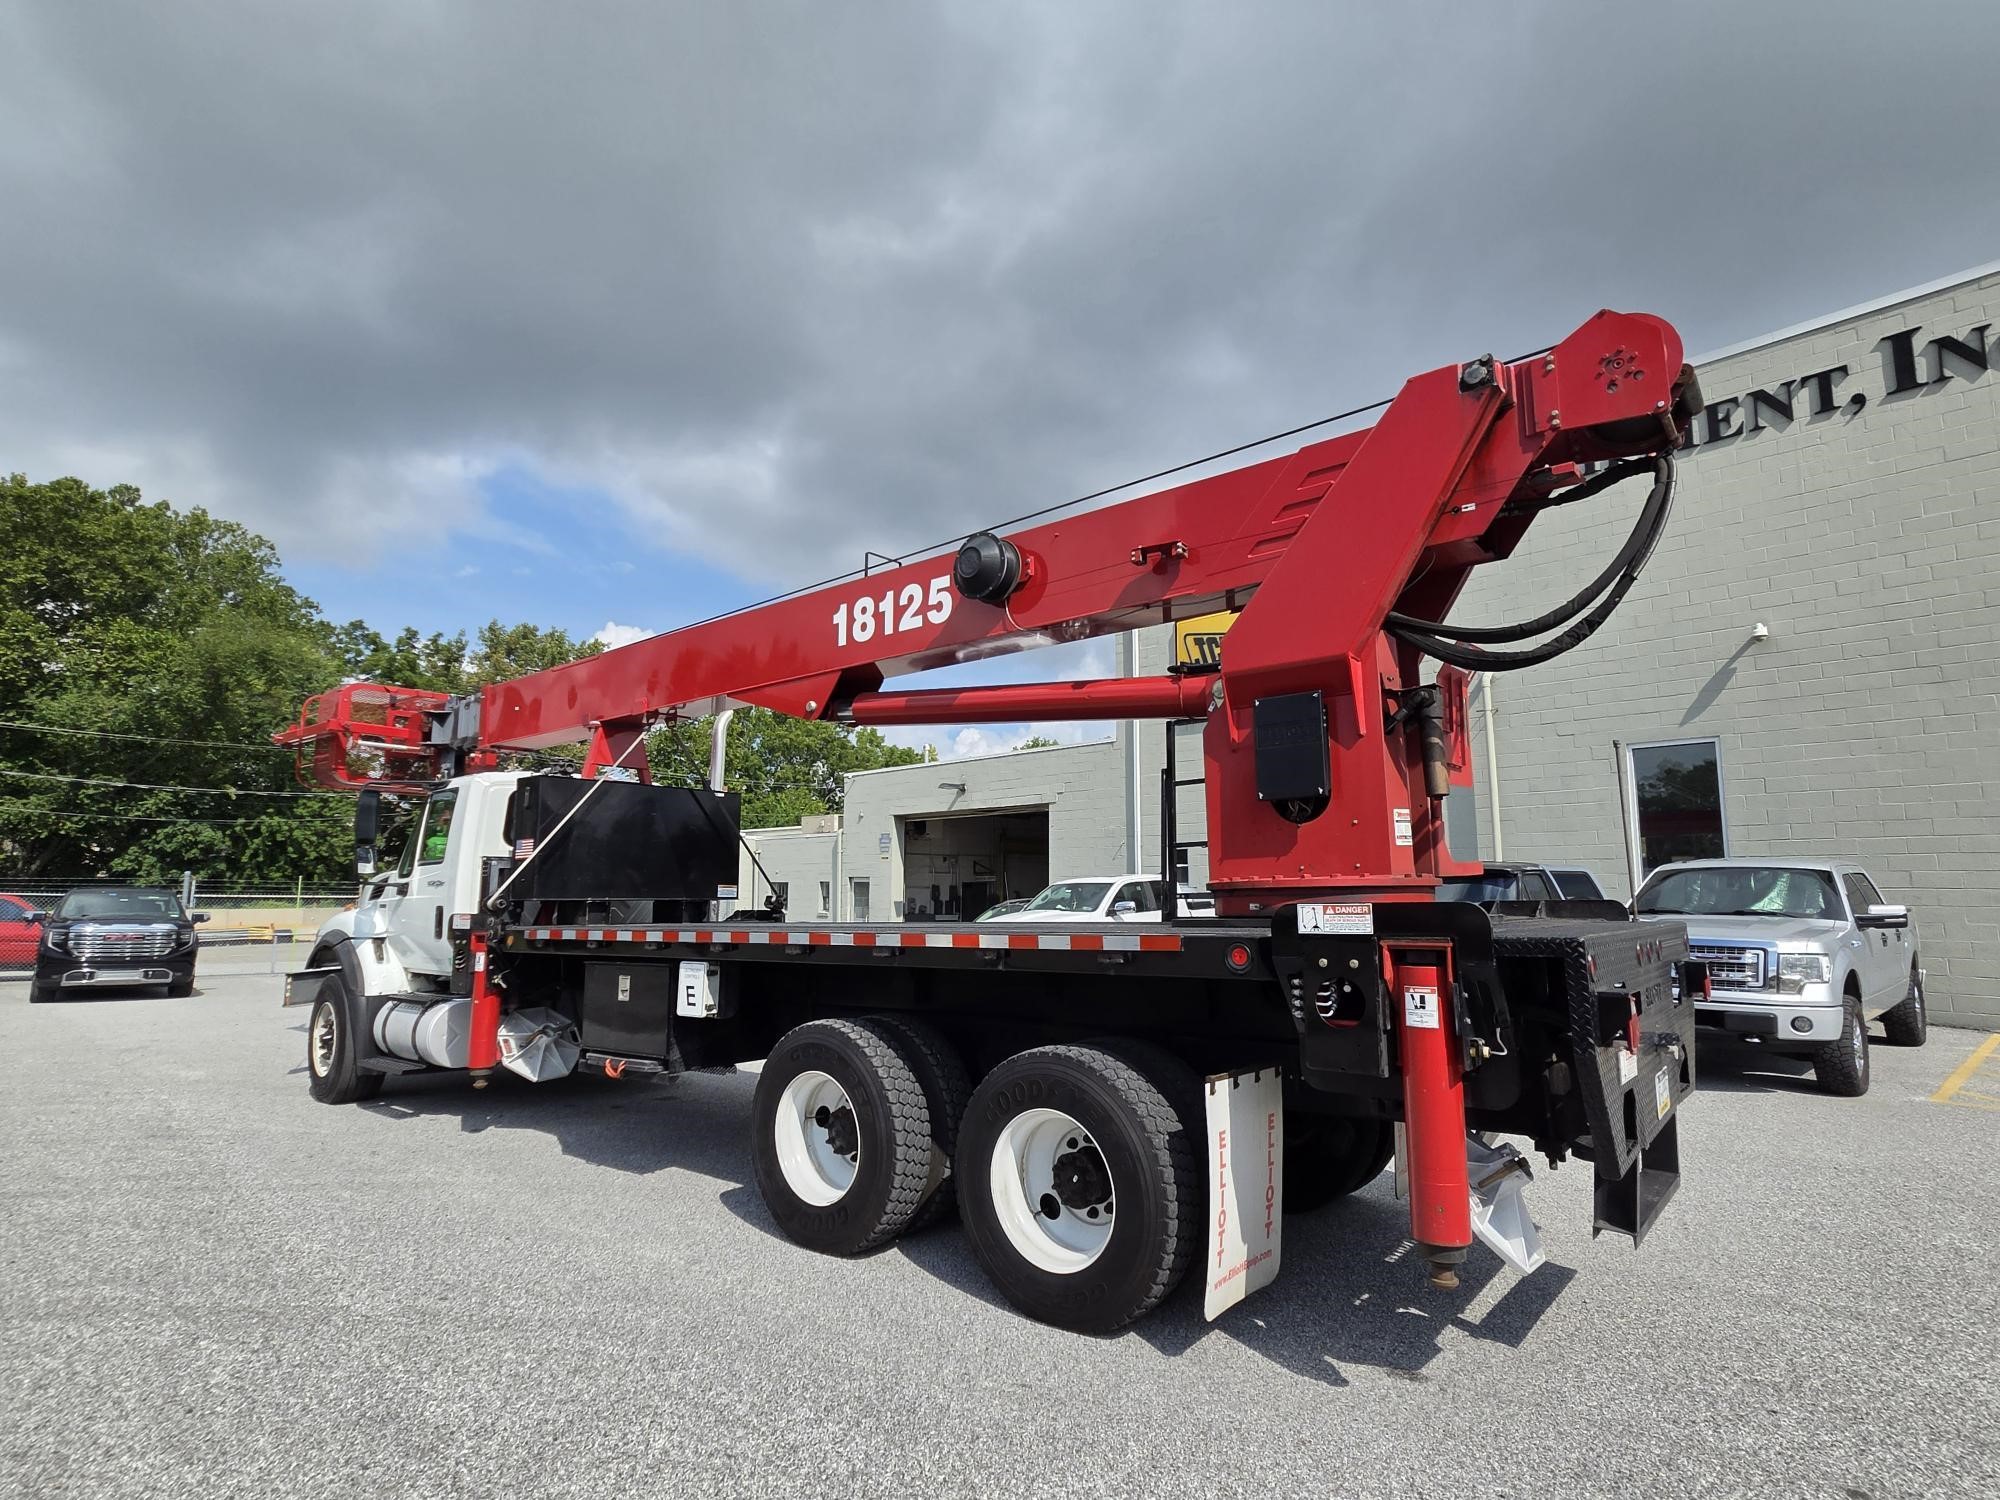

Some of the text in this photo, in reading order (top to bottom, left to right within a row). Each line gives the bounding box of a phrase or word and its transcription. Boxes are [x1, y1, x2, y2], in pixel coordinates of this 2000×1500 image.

[833, 574, 953, 647] 18125
[1193, 636, 1222, 664] JC
[1335, 906, 1369, 914] DANGER
[686, 985, 696, 1006] E
[1217, 1130, 1227, 1269] ELLIOTT
[1265, 1113, 1276, 1240] ELLIOTT
